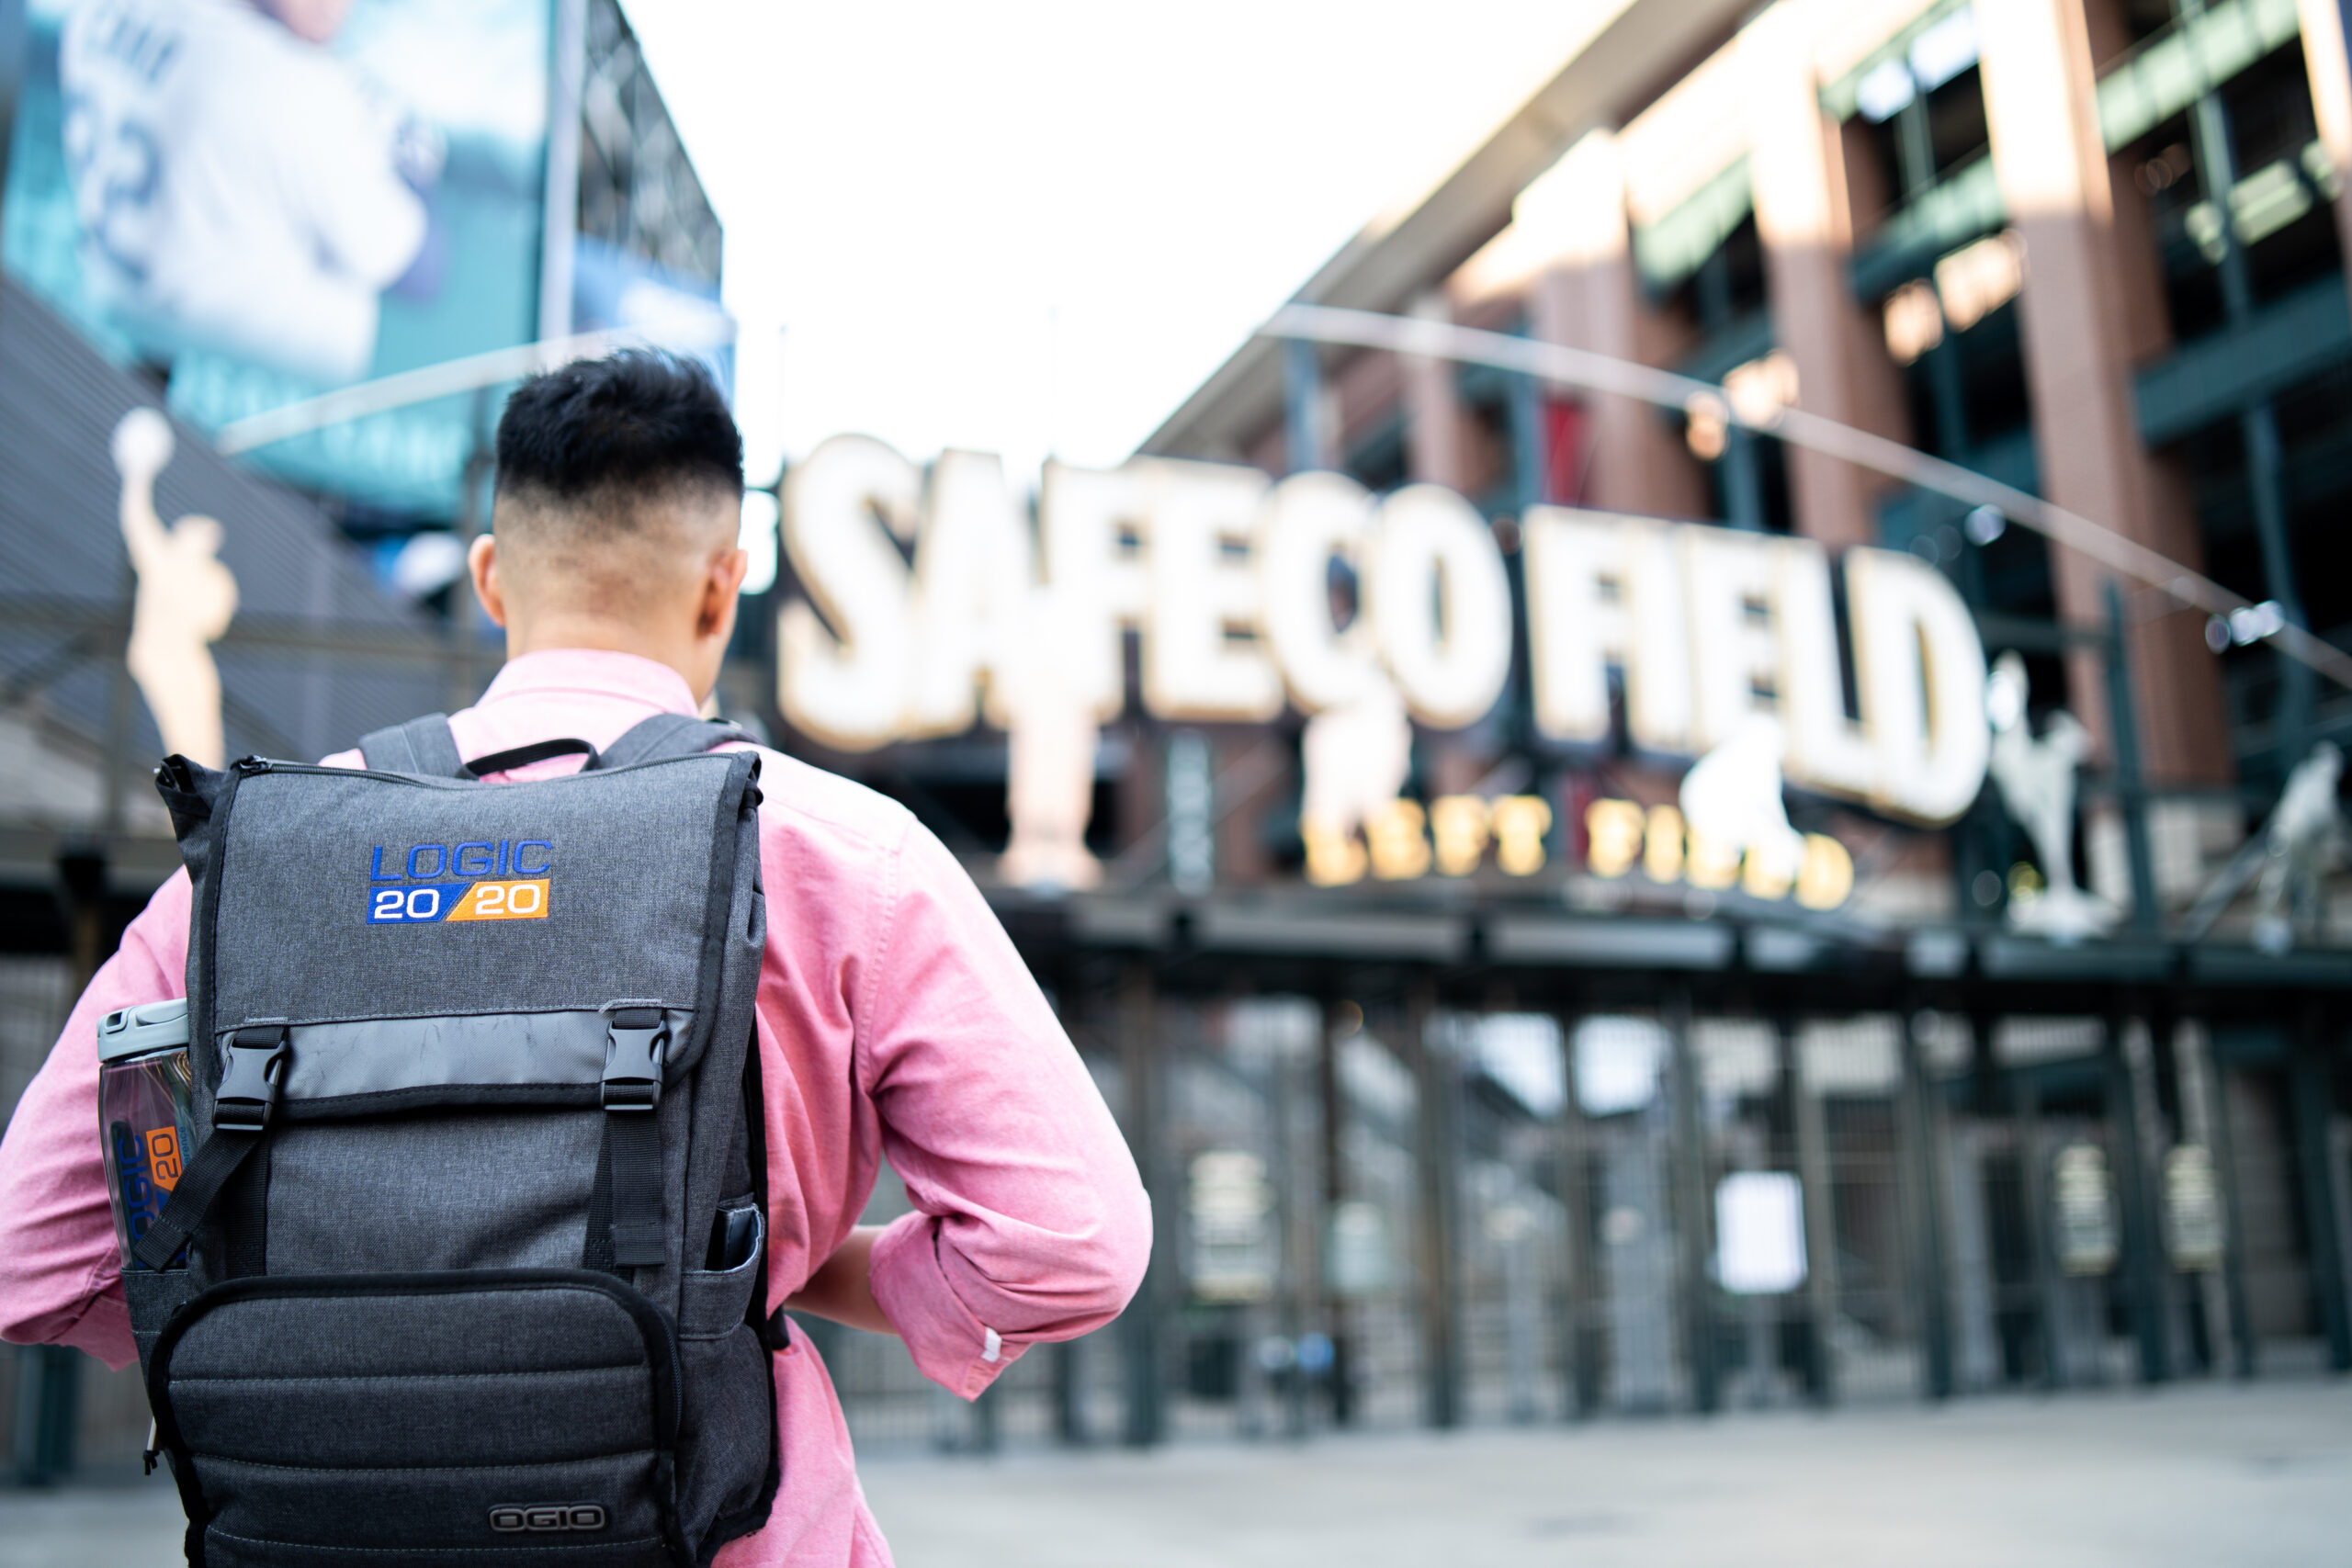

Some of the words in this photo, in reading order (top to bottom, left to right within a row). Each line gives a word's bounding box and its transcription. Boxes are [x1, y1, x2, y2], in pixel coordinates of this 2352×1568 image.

[777, 432, 1514, 751] SAFECO
[1523, 504, 1990, 829] FIELD
[370, 840, 553, 881] LOGIC
[374, 889, 440, 919] 20
[475, 884, 540, 915] 20
[152, 1134, 179, 1180] 20
[179, 1126, 191, 1167] erence
[118, 1134, 154, 1268] OGIC
[489, 1504, 605, 1532] OGIO
